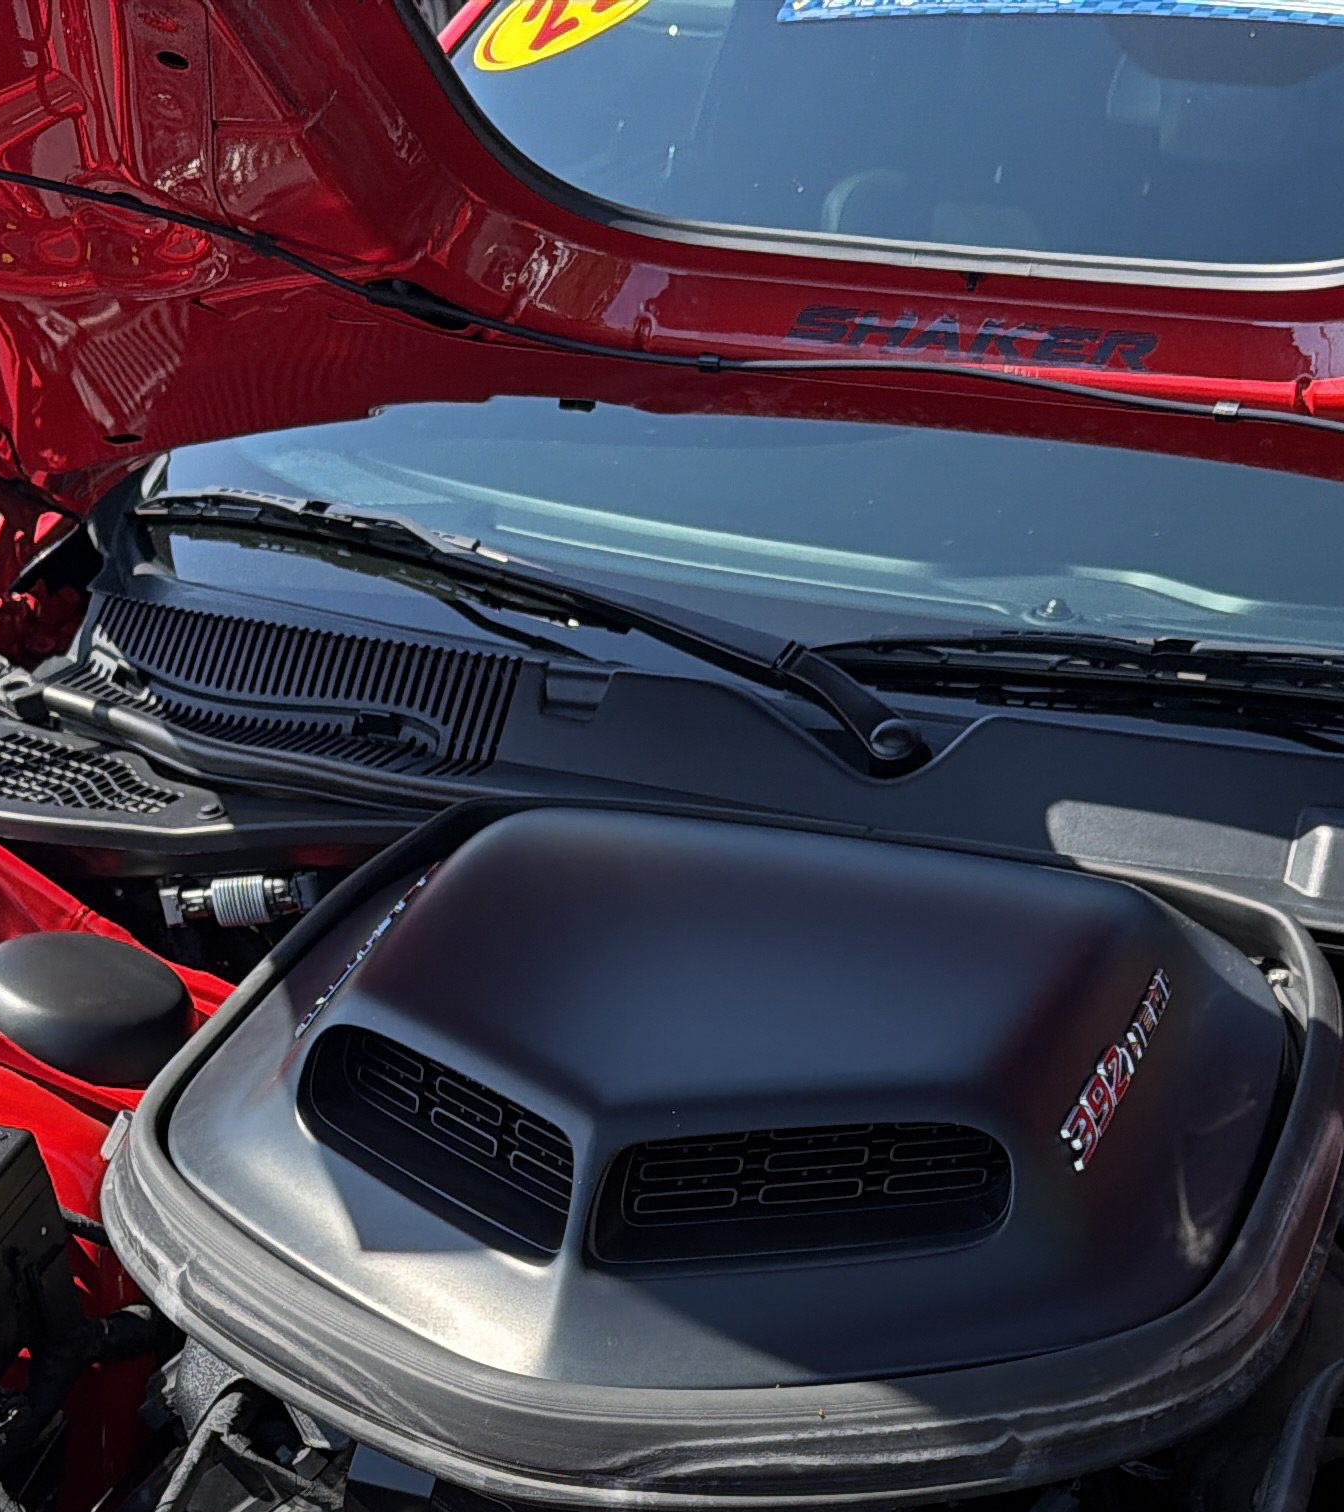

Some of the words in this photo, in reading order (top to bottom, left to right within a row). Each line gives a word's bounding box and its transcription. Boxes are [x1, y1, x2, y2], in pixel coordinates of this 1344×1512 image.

[783, 305, 1158, 373] SHAKER
[1060, 1044, 1135, 1172] 392
[1126, 968, 1172, 1060] HEMI
